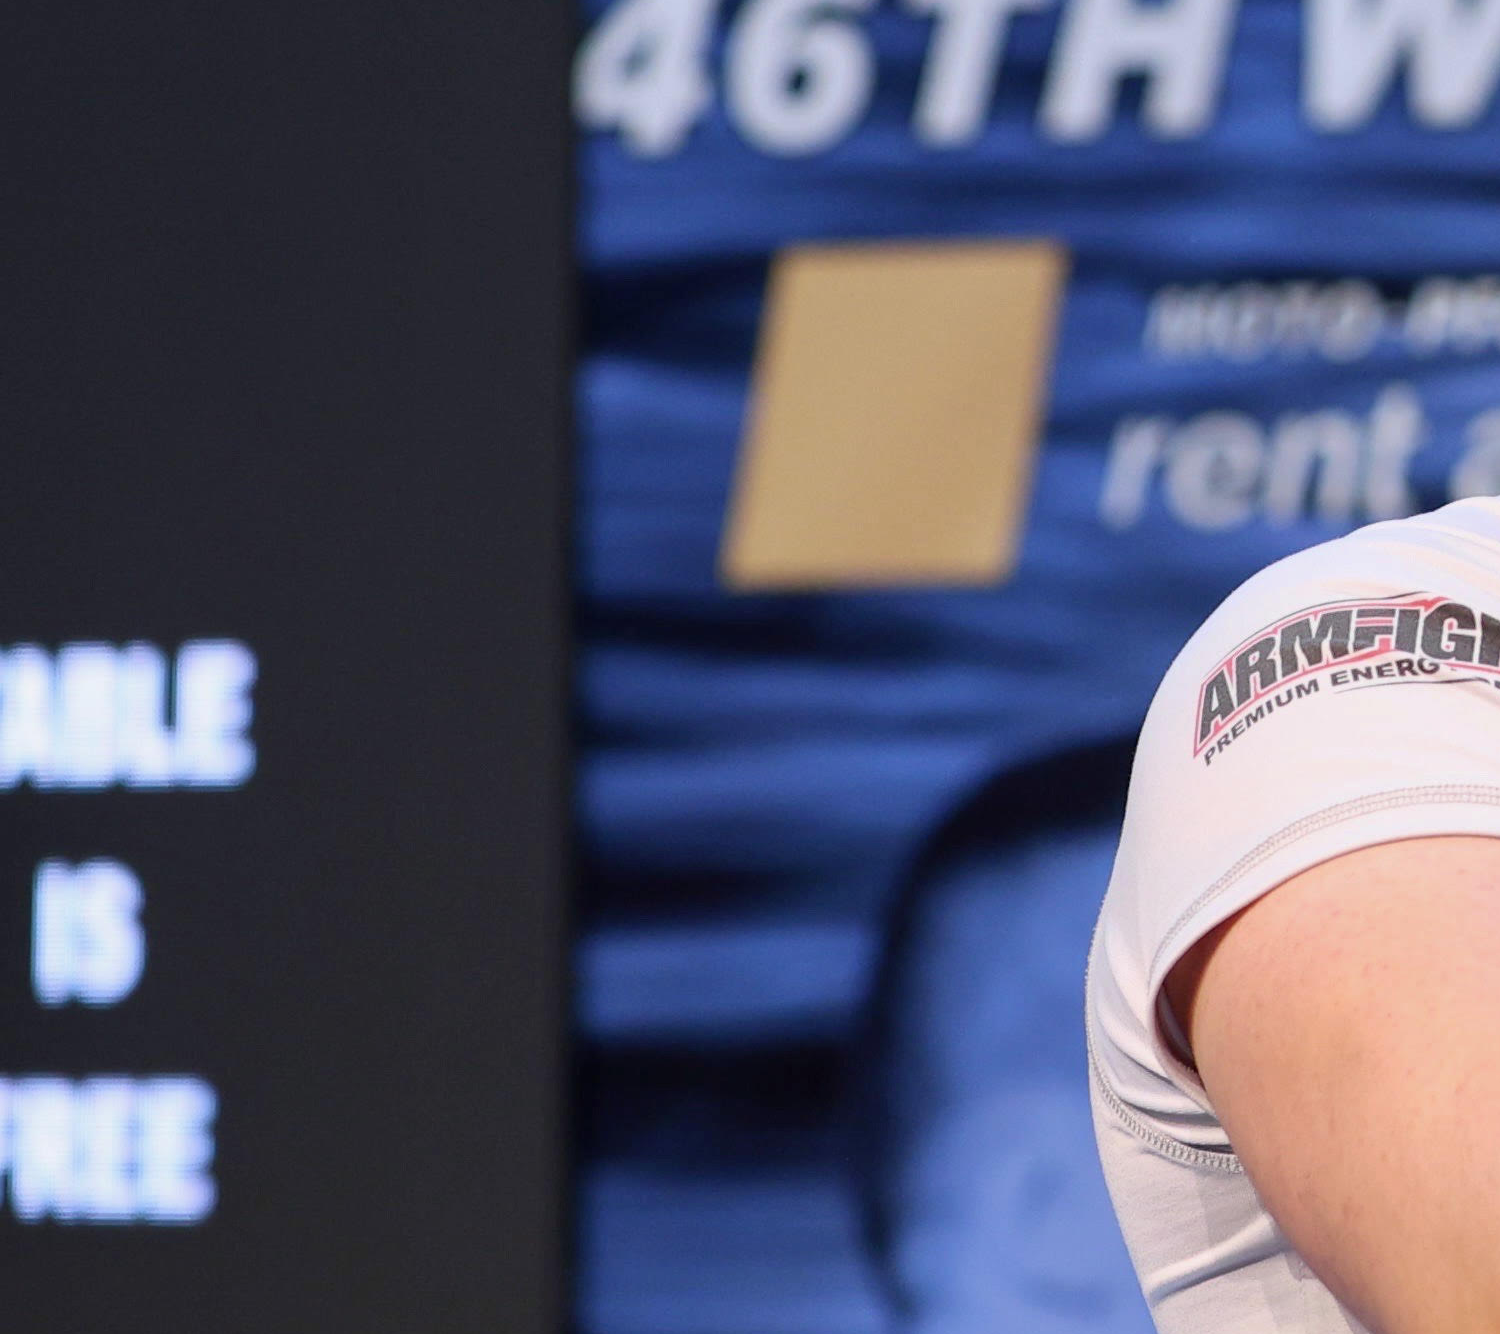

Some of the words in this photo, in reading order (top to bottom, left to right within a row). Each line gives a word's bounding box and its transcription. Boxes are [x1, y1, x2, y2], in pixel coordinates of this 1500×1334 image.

[1098, 379, 1430, 529] rent
[0, 637, 258, 791] ABLE
[1203, 679, 1320, 766] PREMIUM
[1330, 659, 1456, 688] ENERG
[0, 1074, 219, 1225] REE
